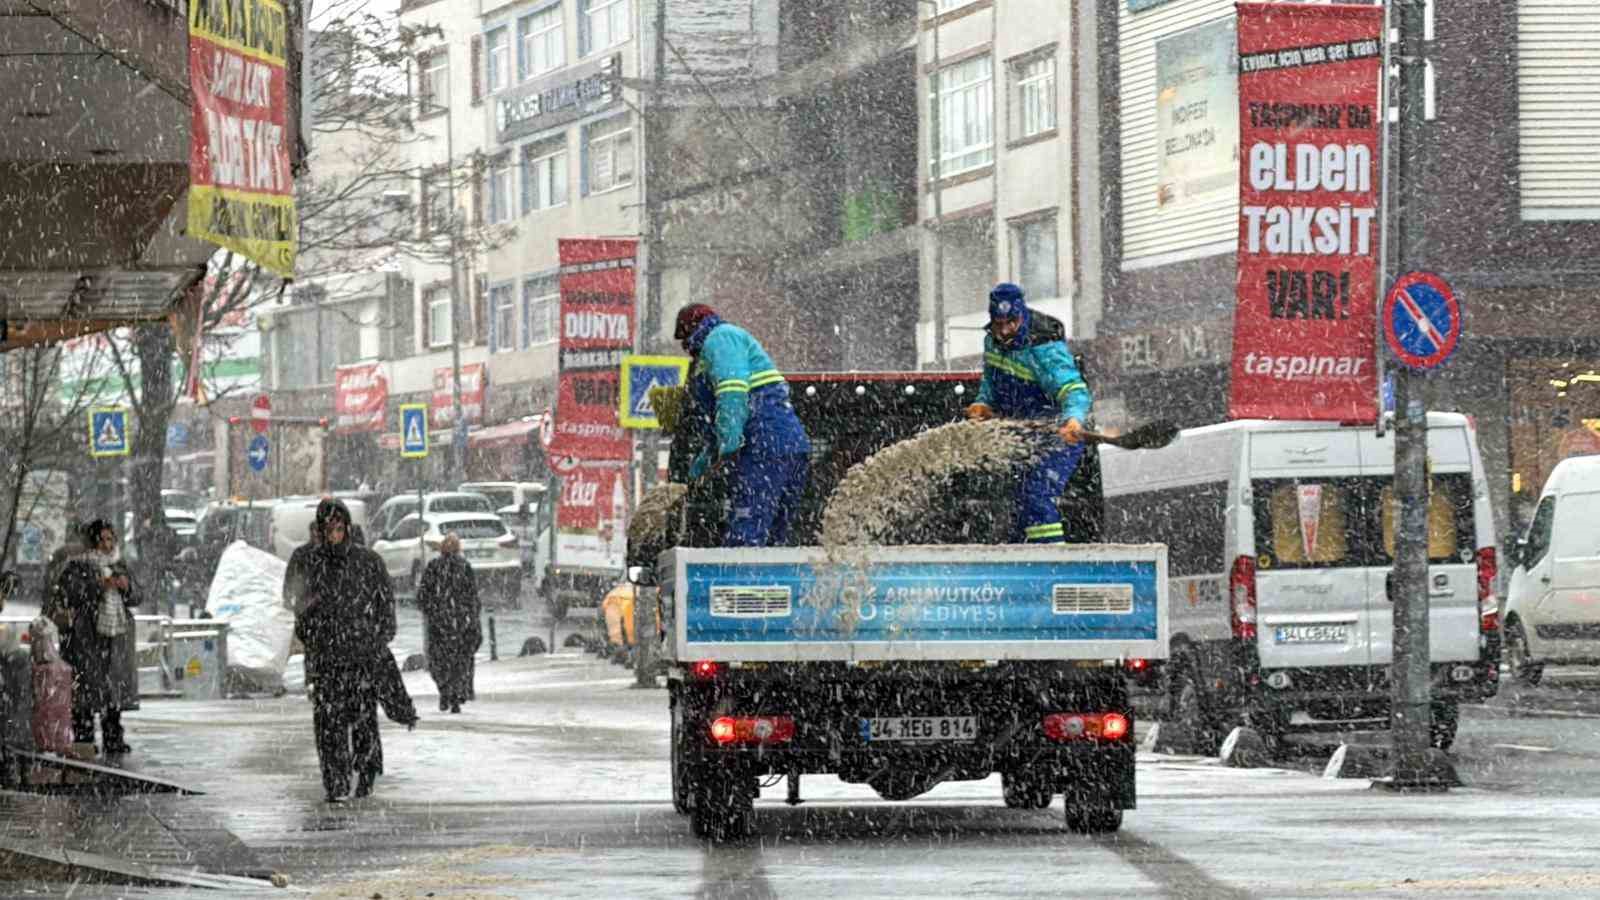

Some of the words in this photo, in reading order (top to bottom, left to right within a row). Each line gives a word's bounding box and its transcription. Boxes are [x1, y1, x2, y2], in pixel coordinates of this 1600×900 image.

[1267, 271, 1350, 320] VAR!
[885, 582, 1005, 602] ARNAVUTKÖY
[883, 603, 1005, 621] BLEDİYESİ
[871, 719, 893, 738] 34
[940, 719, 973, 738] 814
